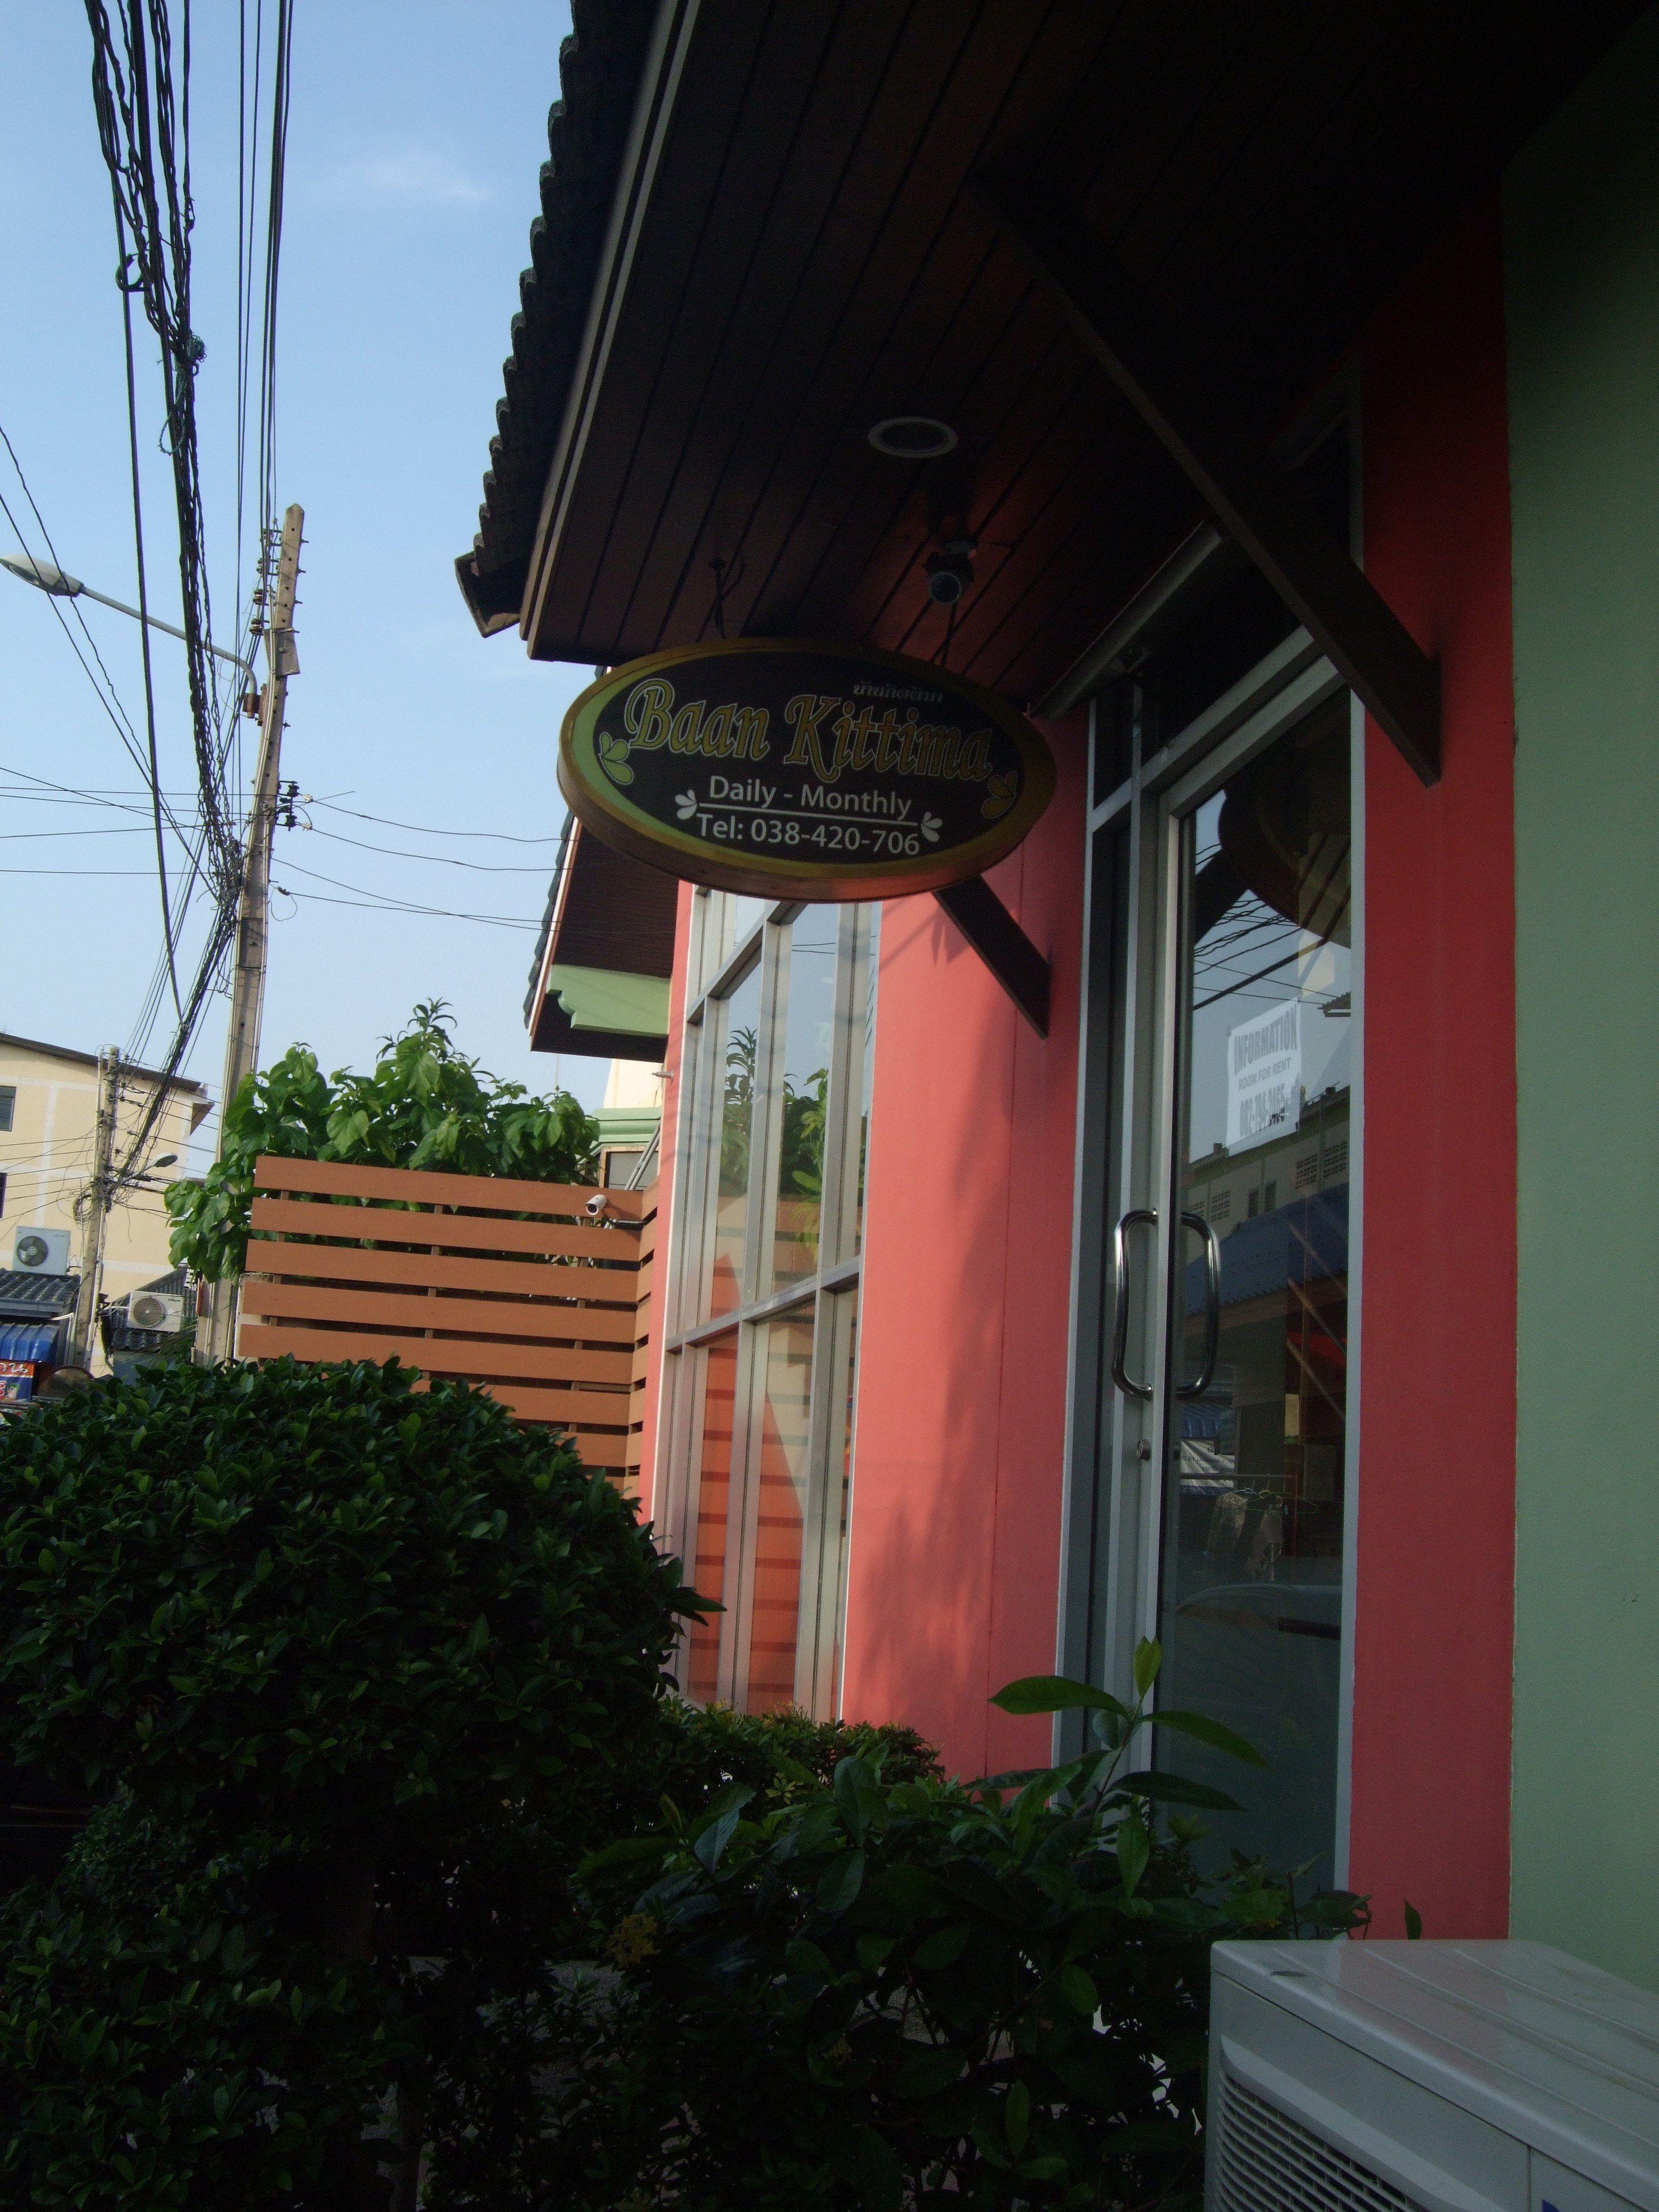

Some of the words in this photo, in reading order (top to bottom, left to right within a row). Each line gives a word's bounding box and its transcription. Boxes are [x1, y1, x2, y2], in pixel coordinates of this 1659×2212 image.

[624, 678, 770, 761] Baan
[783, 695, 993, 783] Kittima
[710, 775, 777, 809] Daily
[801, 784, 911, 821] Monthly
[696, 814, 743, 840] Tel:
[751, 819, 920, 855] 038-420-706
[1234, 1003, 1297, 1075] INFORMATION
[1239, 1074, 1257, 1089] ROOM
[1259, 1067, 1271, 1081] FOR
[1273, 1058, 1291, 1075] RENT
